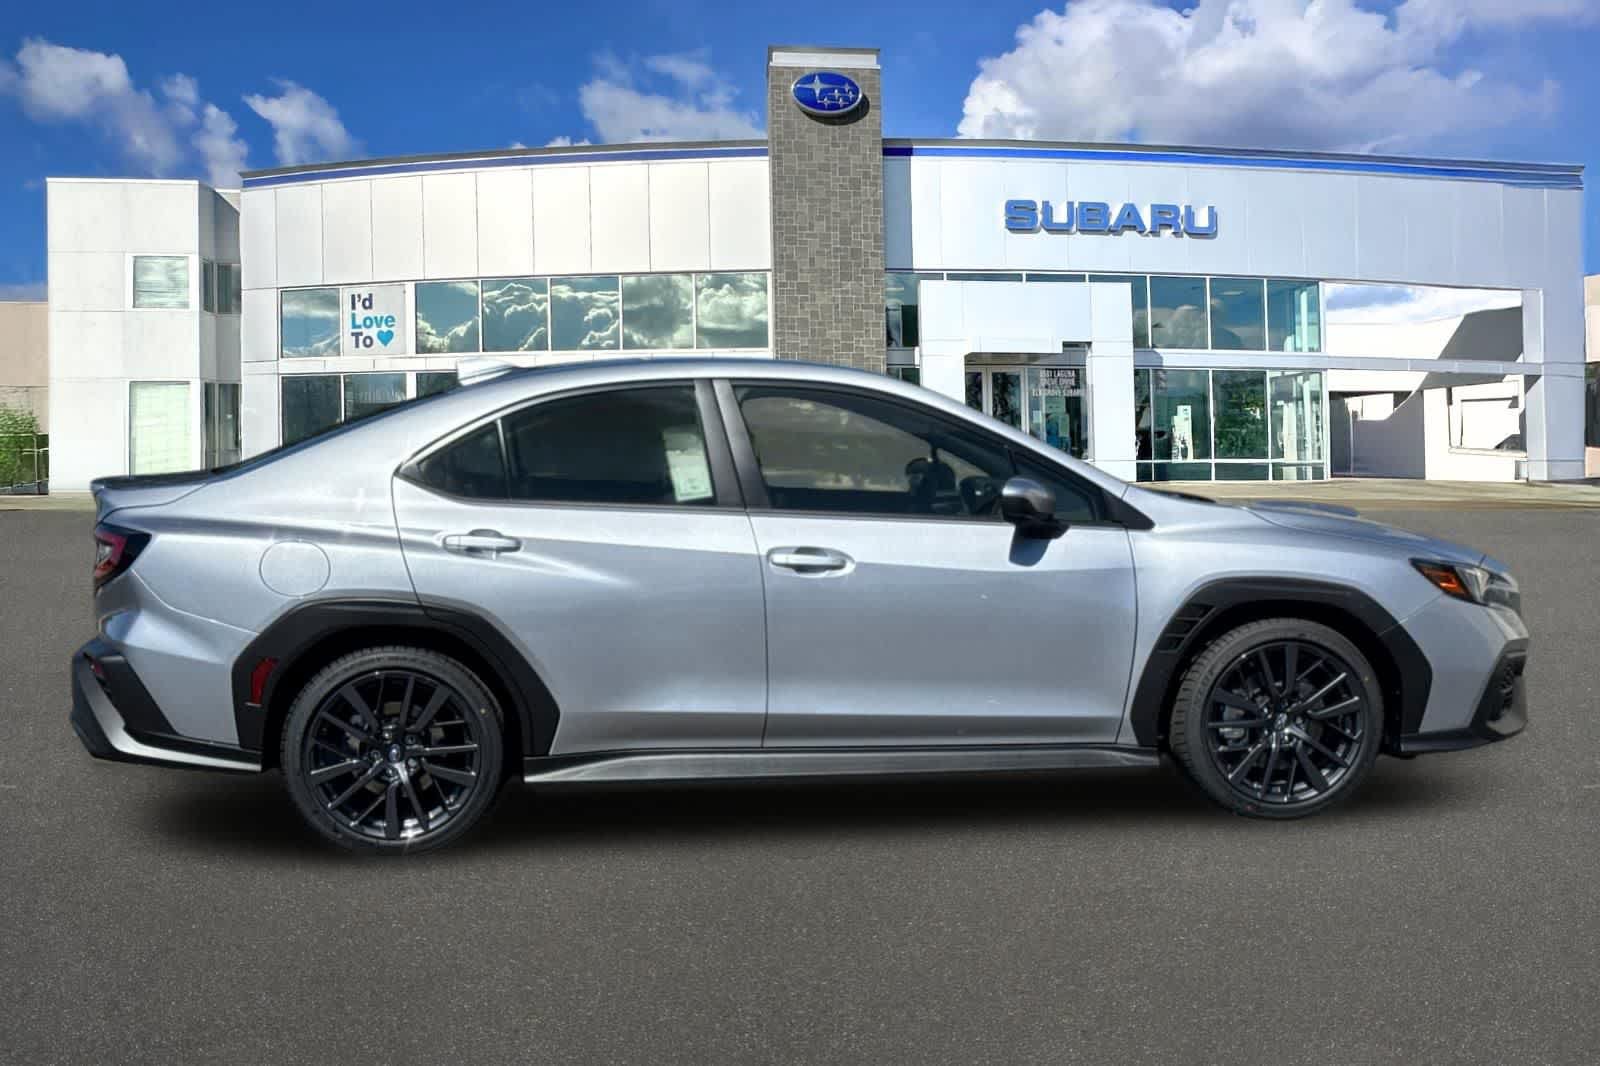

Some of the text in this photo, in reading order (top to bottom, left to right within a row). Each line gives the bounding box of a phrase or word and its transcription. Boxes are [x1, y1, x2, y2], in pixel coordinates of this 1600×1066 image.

[1005, 199, 1217, 239] SUBARU
[351, 293, 373, 310] I'd
[351, 312, 396, 329] Love
[351, 332, 374, 348] To
